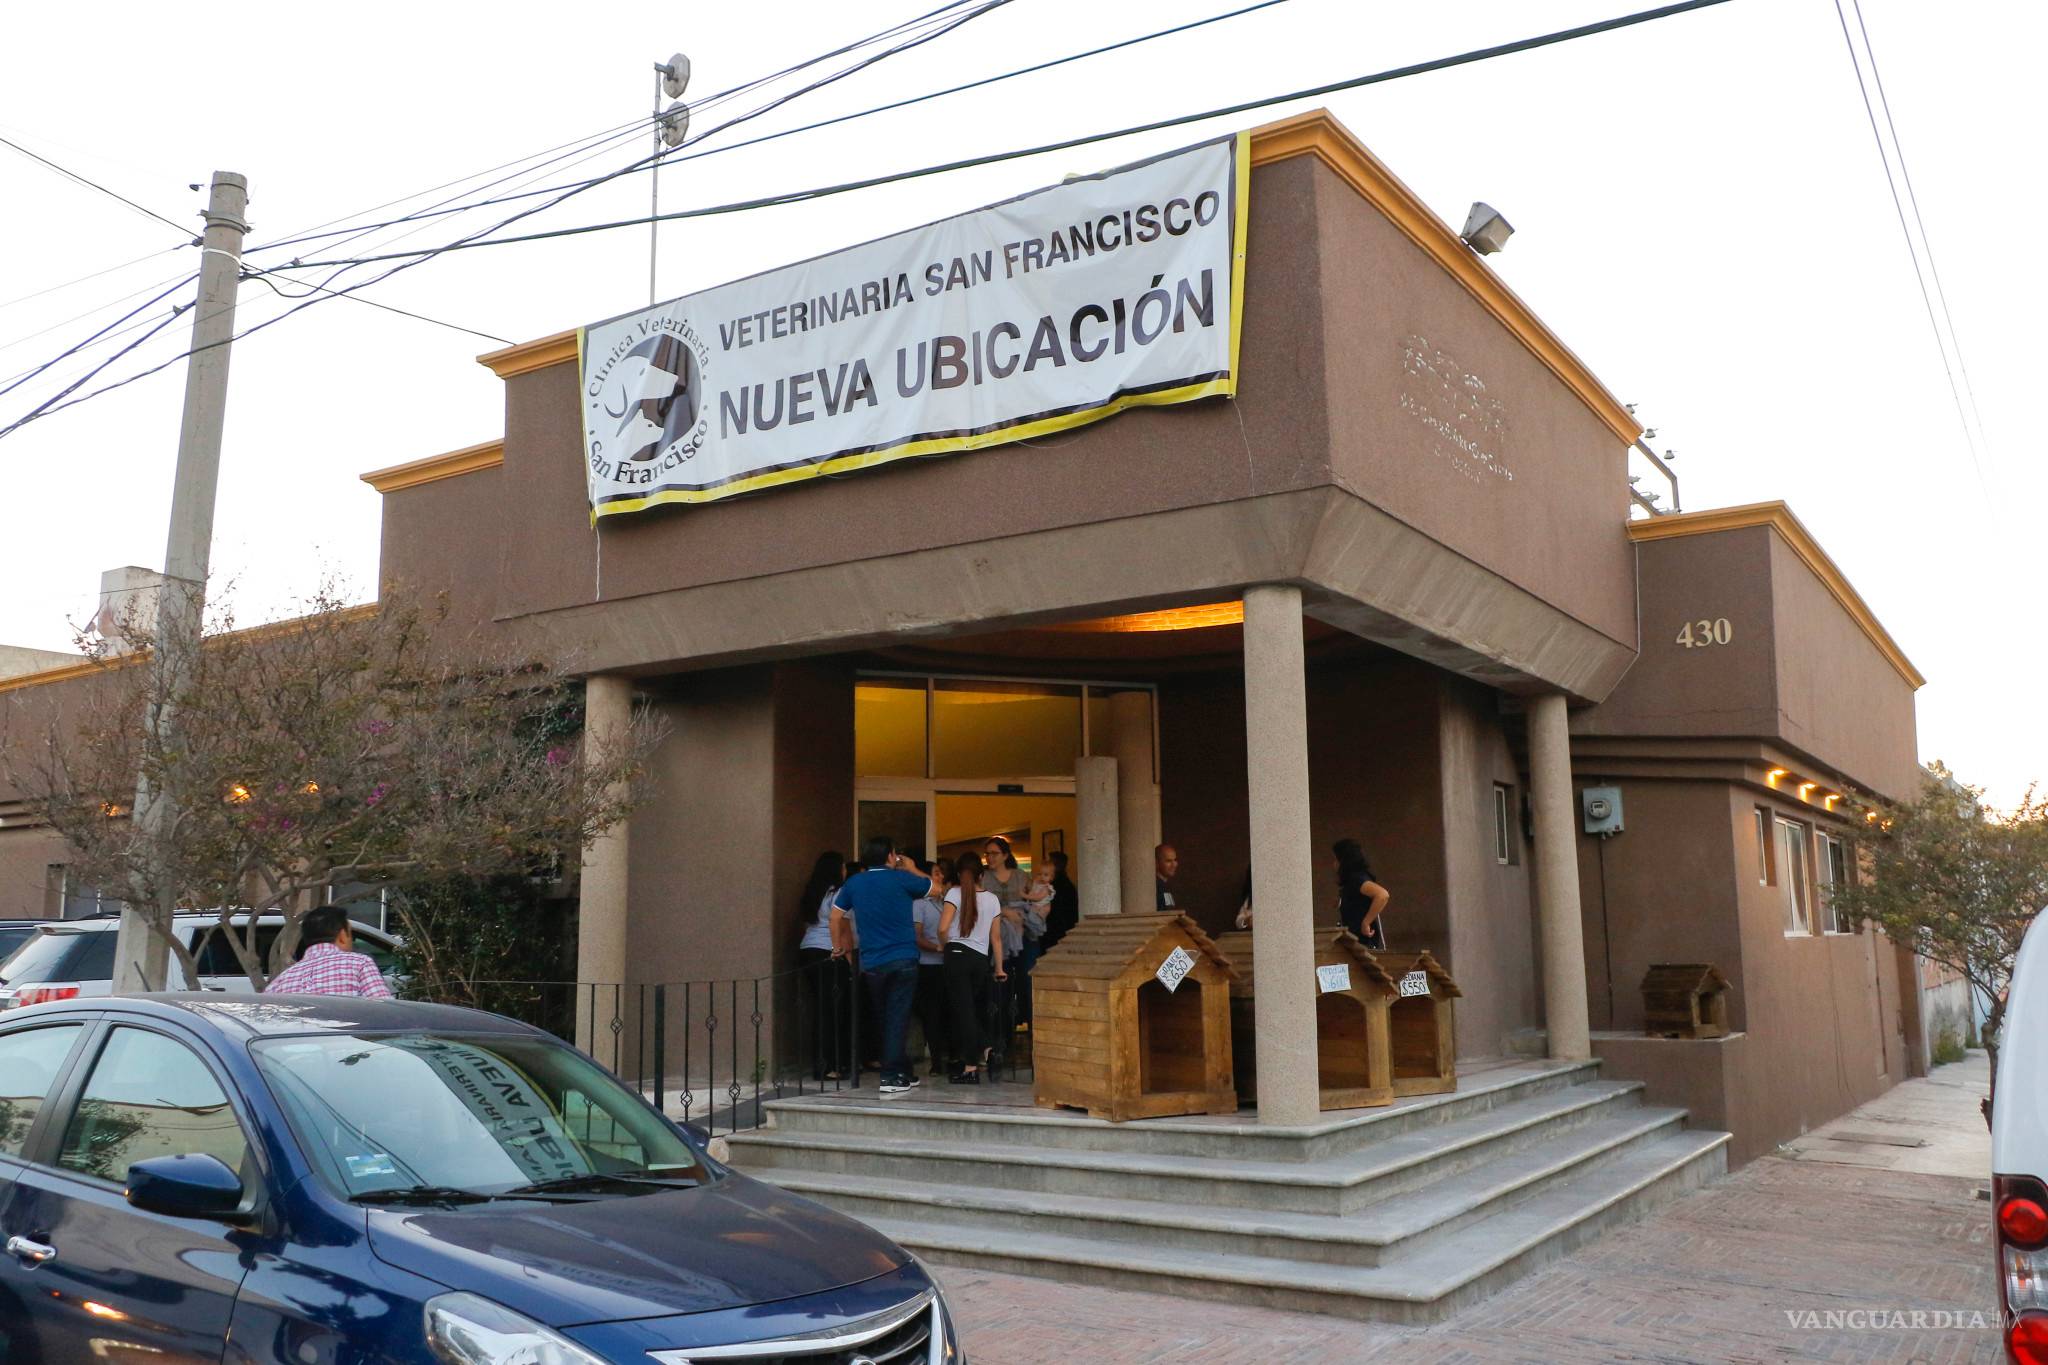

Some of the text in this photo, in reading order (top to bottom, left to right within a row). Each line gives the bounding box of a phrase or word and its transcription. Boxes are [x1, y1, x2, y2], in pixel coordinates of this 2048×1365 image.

[719, 190, 1220, 351] VETERINARIA SAN FRANCISCO
[637, 316, 710, 367] Veterinaria
[720, 268, 1214, 440] NUEVA UBICACIÓN
[591, 419, 708, 483] San Francisco
[1676, 618, 1732, 648] 430
